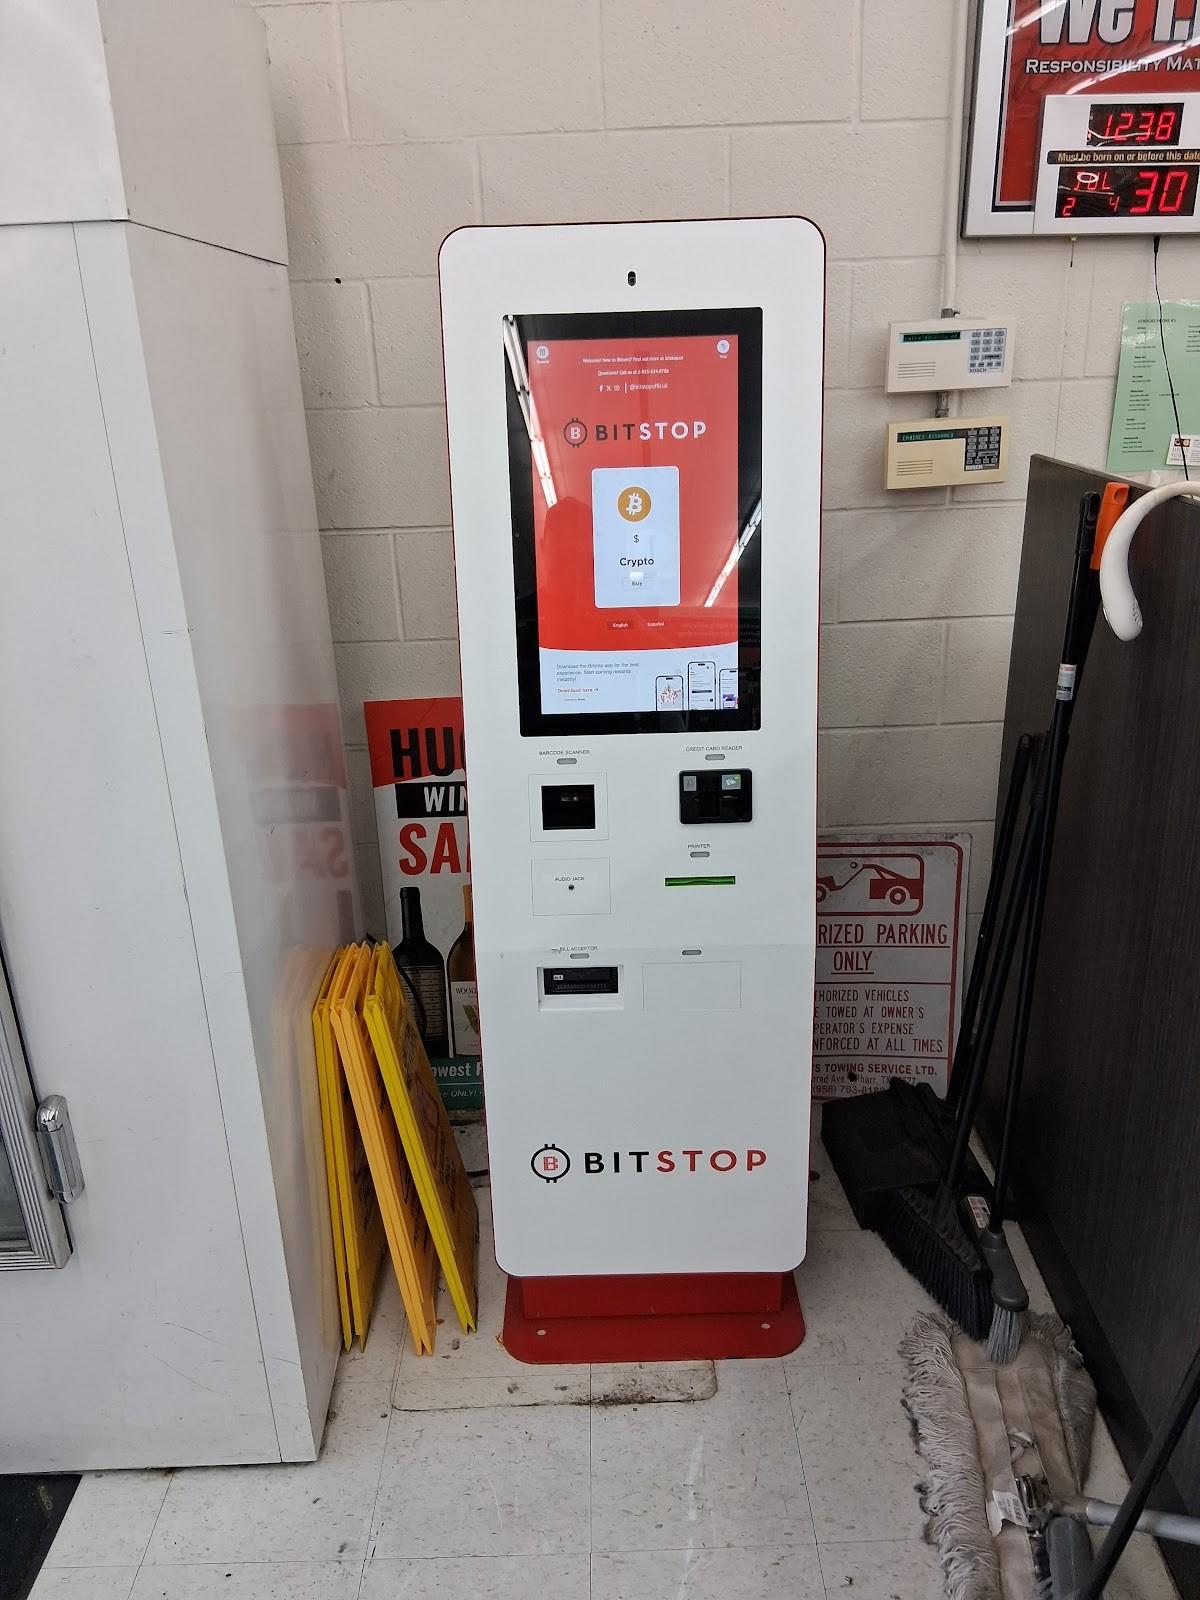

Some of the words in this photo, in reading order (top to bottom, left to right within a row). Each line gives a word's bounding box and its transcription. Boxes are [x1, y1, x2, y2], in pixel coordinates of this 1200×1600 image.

[1103, 111, 1177, 142] 1238
[1058, 153, 1079, 162] Must
[1081, 152, 1091, 162] be
[1093, 152, 1114, 162] born
[1126, 153, 1136, 161] or
[1137, 152, 1164, 161] before
[1166, 151, 1182, 161] this
[1130, 171, 1190, 214] 30
[595, 421, 707, 441] BITSTOP
[619, 557, 655, 568] Crypto
[390, 726, 466, 778] HU
[399, 822, 472, 876] SA
[818, 924, 864, 944] RIZED
[877, 923, 948, 944] PARKING
[833, 951, 873, 971] ONLY
[865, 990, 910, 1002] VEHICLES
[826, 1006, 857, 1018] TOWED
[864, 1007, 874, 1018] AT
[881, 1007, 924, 1019] OWNER'S
[872, 1023, 914, 1035] EXPENSE
[867, 1038, 880, 1051] AT
[885, 1039, 906, 1052] ALL
[912, 1039, 943, 1053] TIMES
[825, 1063, 864, 1073] TOWING
[868, 1064, 911, 1075] SERVICE
[915, 1066, 937, 1076] LTD.
[451, 1089, 477, 1098] ONLY!
[584, 1149, 767, 1174] BITSTOP
